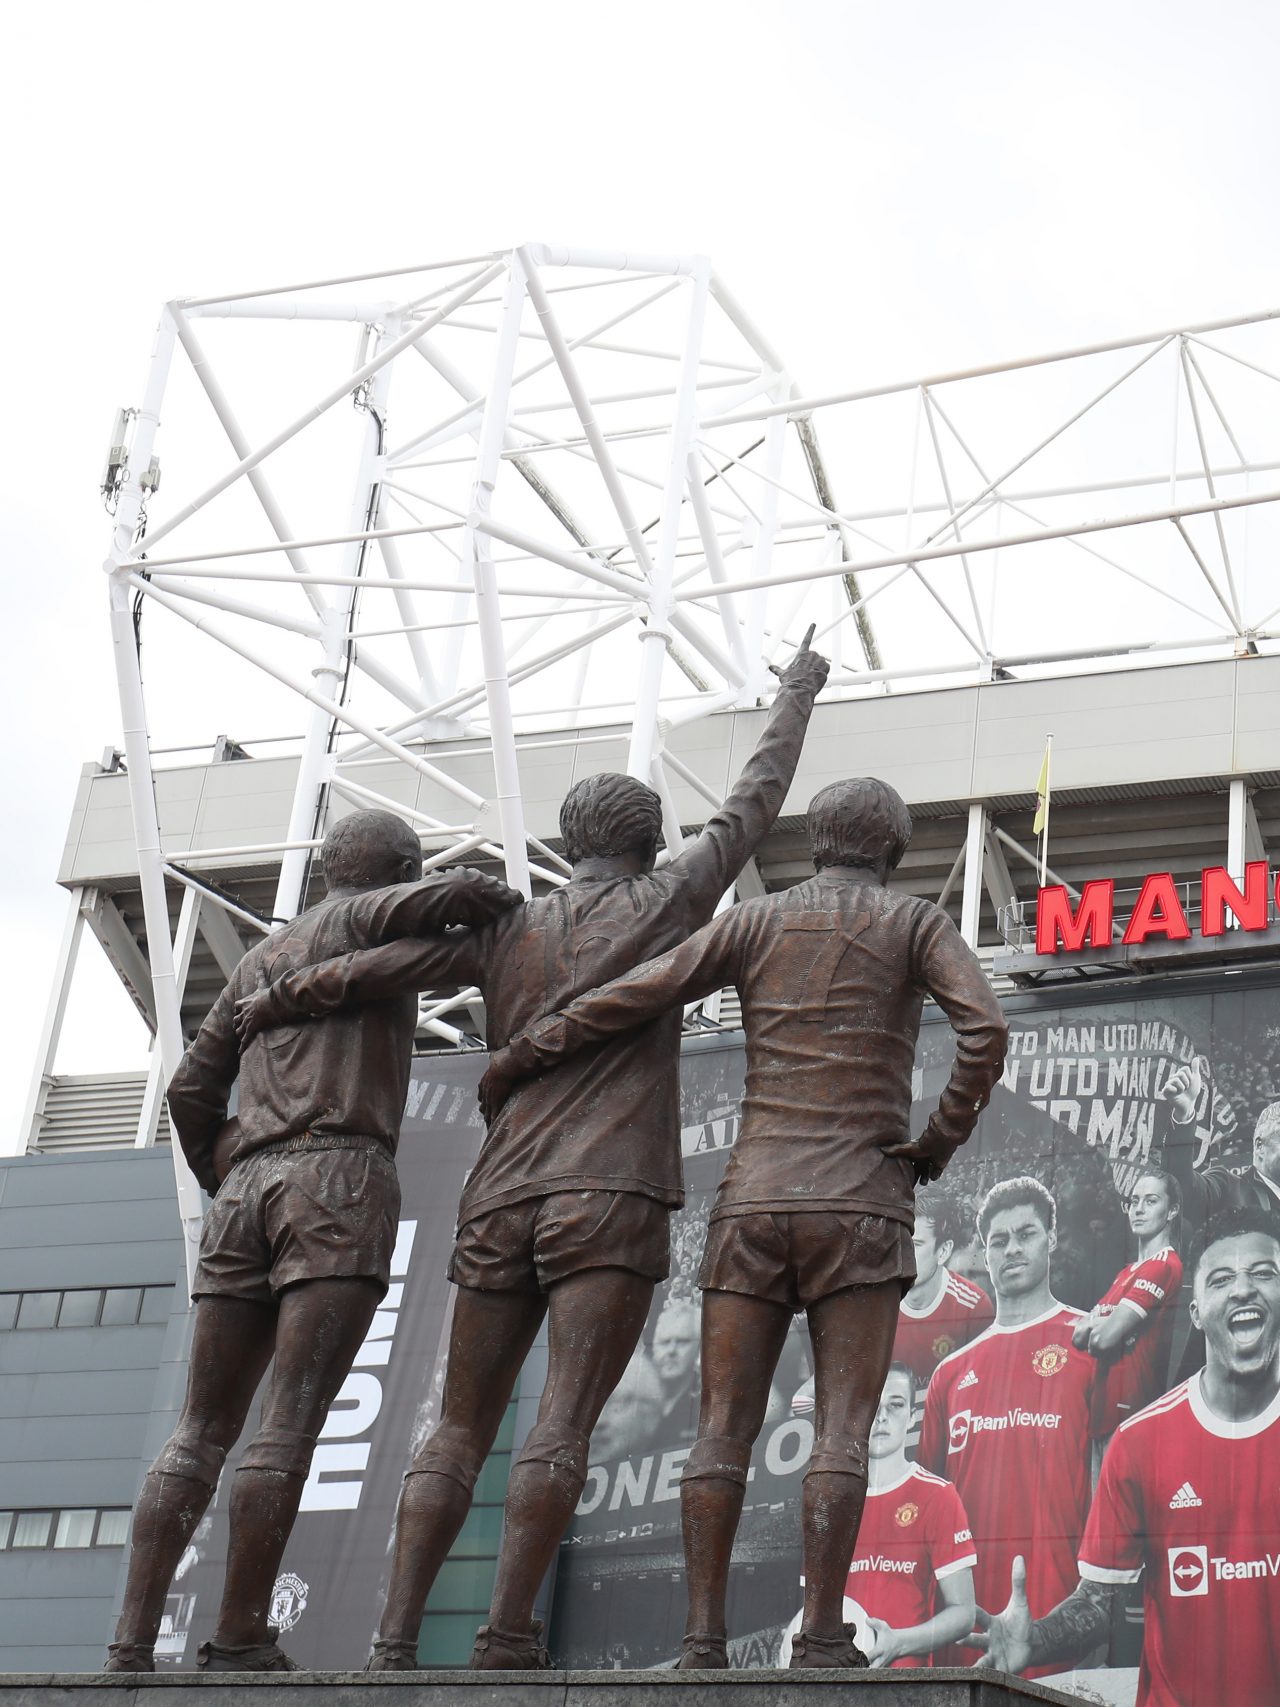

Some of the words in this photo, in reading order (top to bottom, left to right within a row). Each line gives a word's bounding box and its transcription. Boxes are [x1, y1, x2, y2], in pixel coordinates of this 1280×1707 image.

[1008, 1031, 1038, 1056] TD
[1047, 1026, 1096, 1055] MAN
[1104, 1023, 1138, 1052] UTD
[1140, 1021, 1176, 1054] MAN
[1029, 1057, 1099, 1097] UTD
[1107, 1056, 1151, 1098] MAN
[1134, 1278, 1165, 1300] KOHLER
[971, 1408, 1062, 1433] TeamViewer
[574, 1448, 694, 1516] ONE
[1169, 1498, 1203, 1510] adidas
[850, 1555, 917, 1574] amViewer
